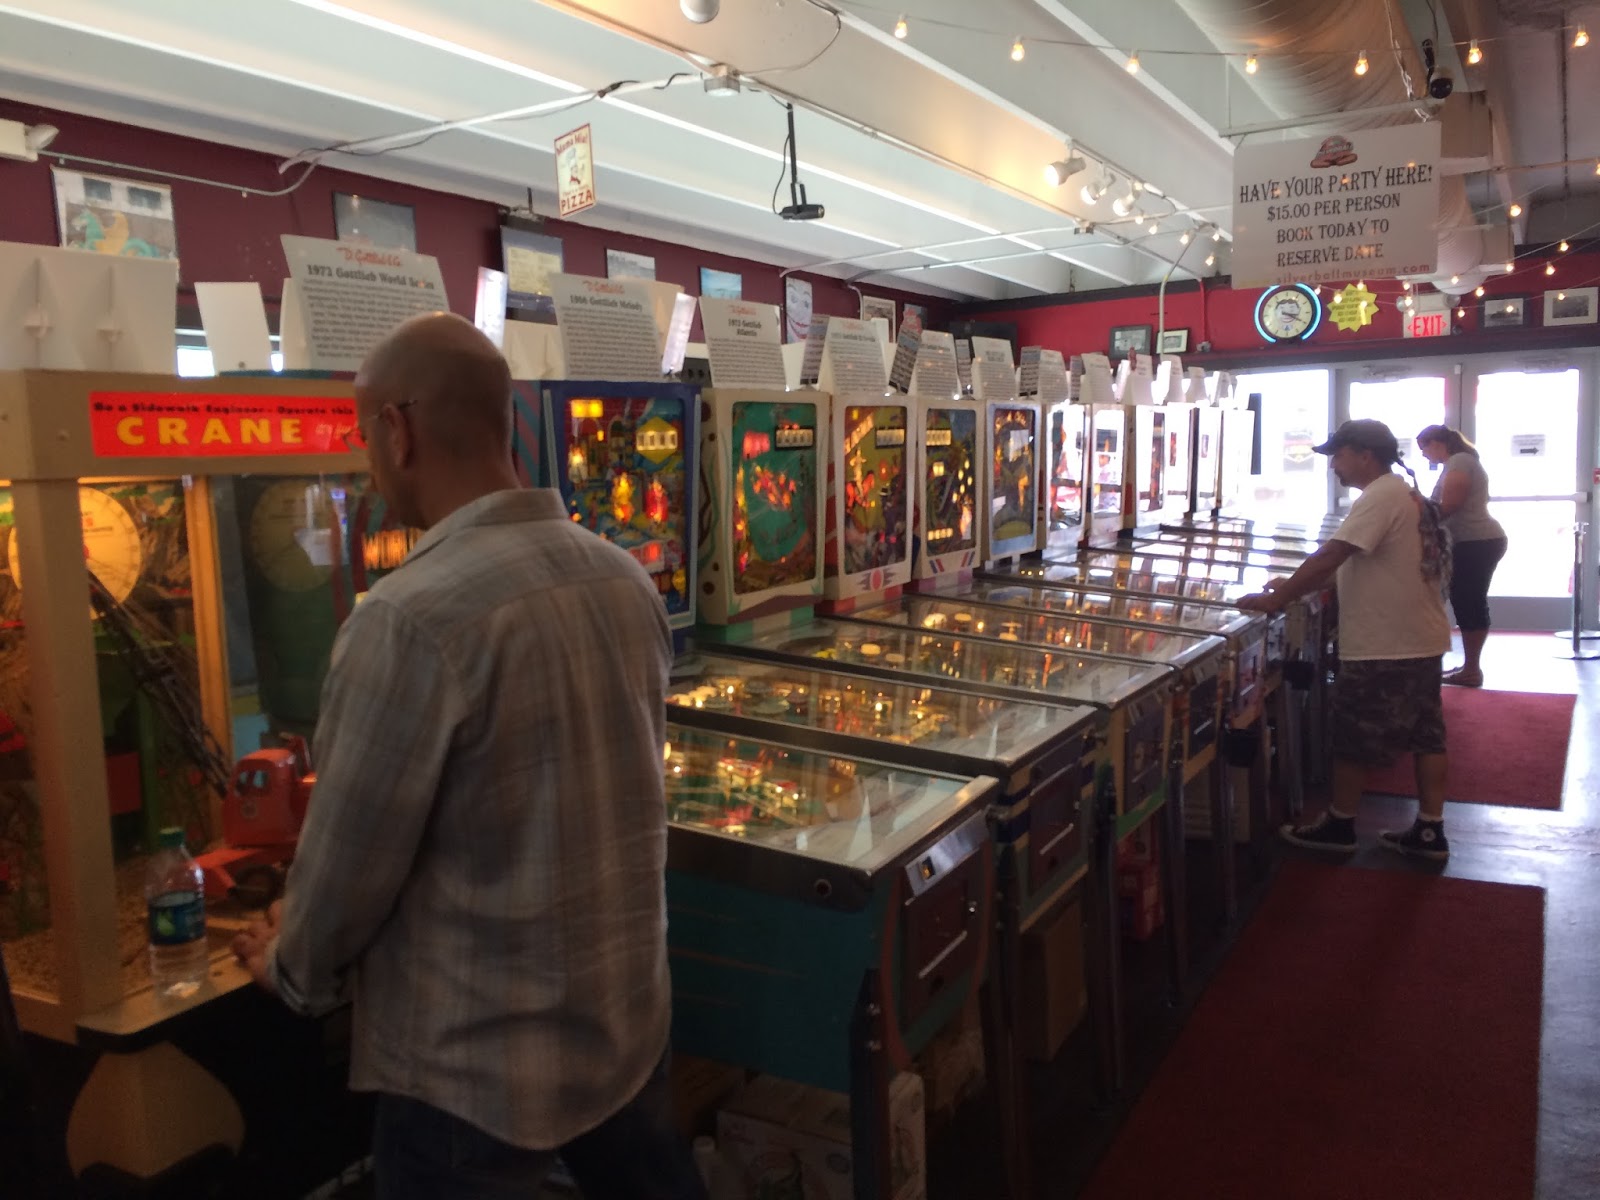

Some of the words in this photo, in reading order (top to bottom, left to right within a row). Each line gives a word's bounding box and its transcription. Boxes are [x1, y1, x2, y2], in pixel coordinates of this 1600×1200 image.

[1240, 179, 1280, 203] HAVE
[1285, 175, 1324, 198] YOUR
[1329, 166, 1382, 193] PARTY
[1386, 164, 1433, 187] HERE!
[561, 189, 593, 212] PIZZA
[1267, 202, 1310, 222] $15.00
[1314, 199, 1341, 216] PER
[1345, 193, 1401, 213] PERSON
[1277, 226, 1313, 244] BOOK
[1319, 218, 1369, 240] TODAY
[1371, 218, 1389, 235] TO
[1277, 246, 1340, 267] RESERVE
[1344, 243, 1384, 262] DATE
[336, 267, 376, 282] Gottlieb
[379, 272, 407, 286] World
[409, 276, 434, 289] Seies
[1276, 263, 1430, 285] silverballmuseum.com
[1413, 314, 1443, 337] EXIT
[132, 402, 199, 413] Sidewalk
[206, 404, 263, 415] Engineer
[277, 405, 326, 415] Operate
[116, 416, 303, 446] CRANE
